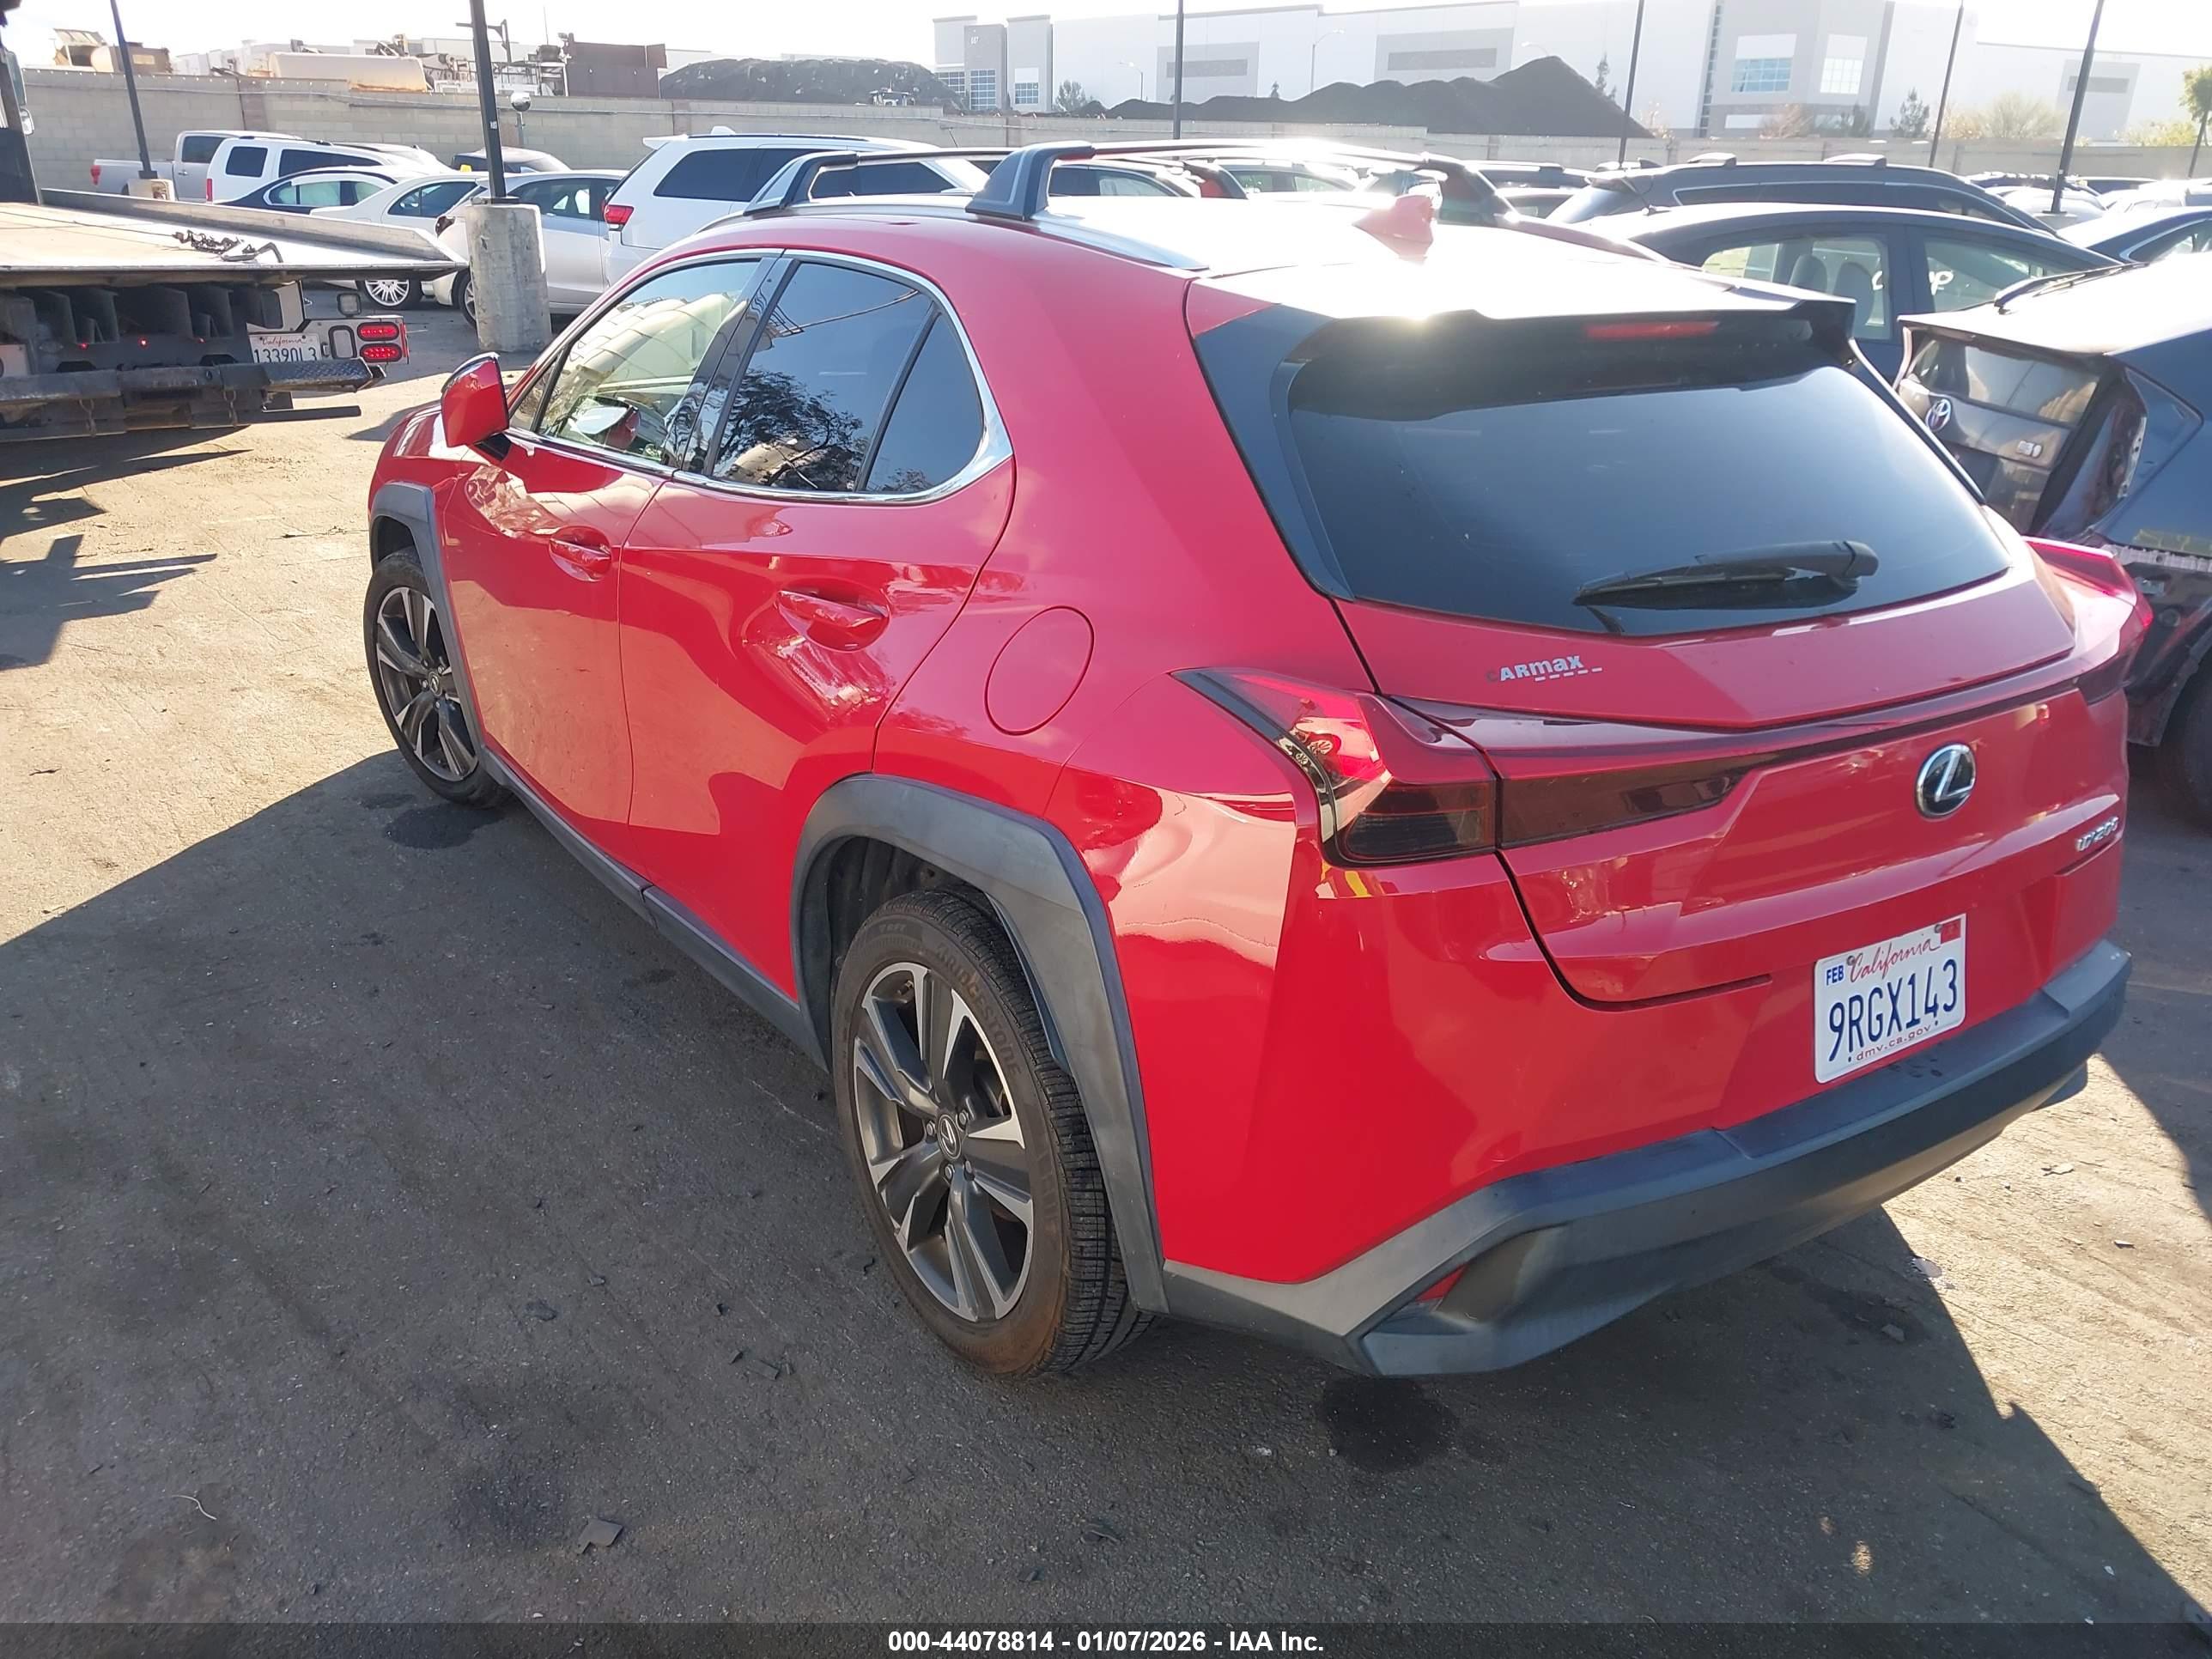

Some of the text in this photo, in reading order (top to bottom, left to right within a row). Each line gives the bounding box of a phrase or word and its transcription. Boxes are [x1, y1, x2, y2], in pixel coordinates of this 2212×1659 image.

[1826, 964, 1844, 986] FEB
[1849, 938, 1941, 983] California
[1828, 958, 1958, 1062] 9RGX143
[1856, 1024, 1931, 1061] dmv.ca.gov
